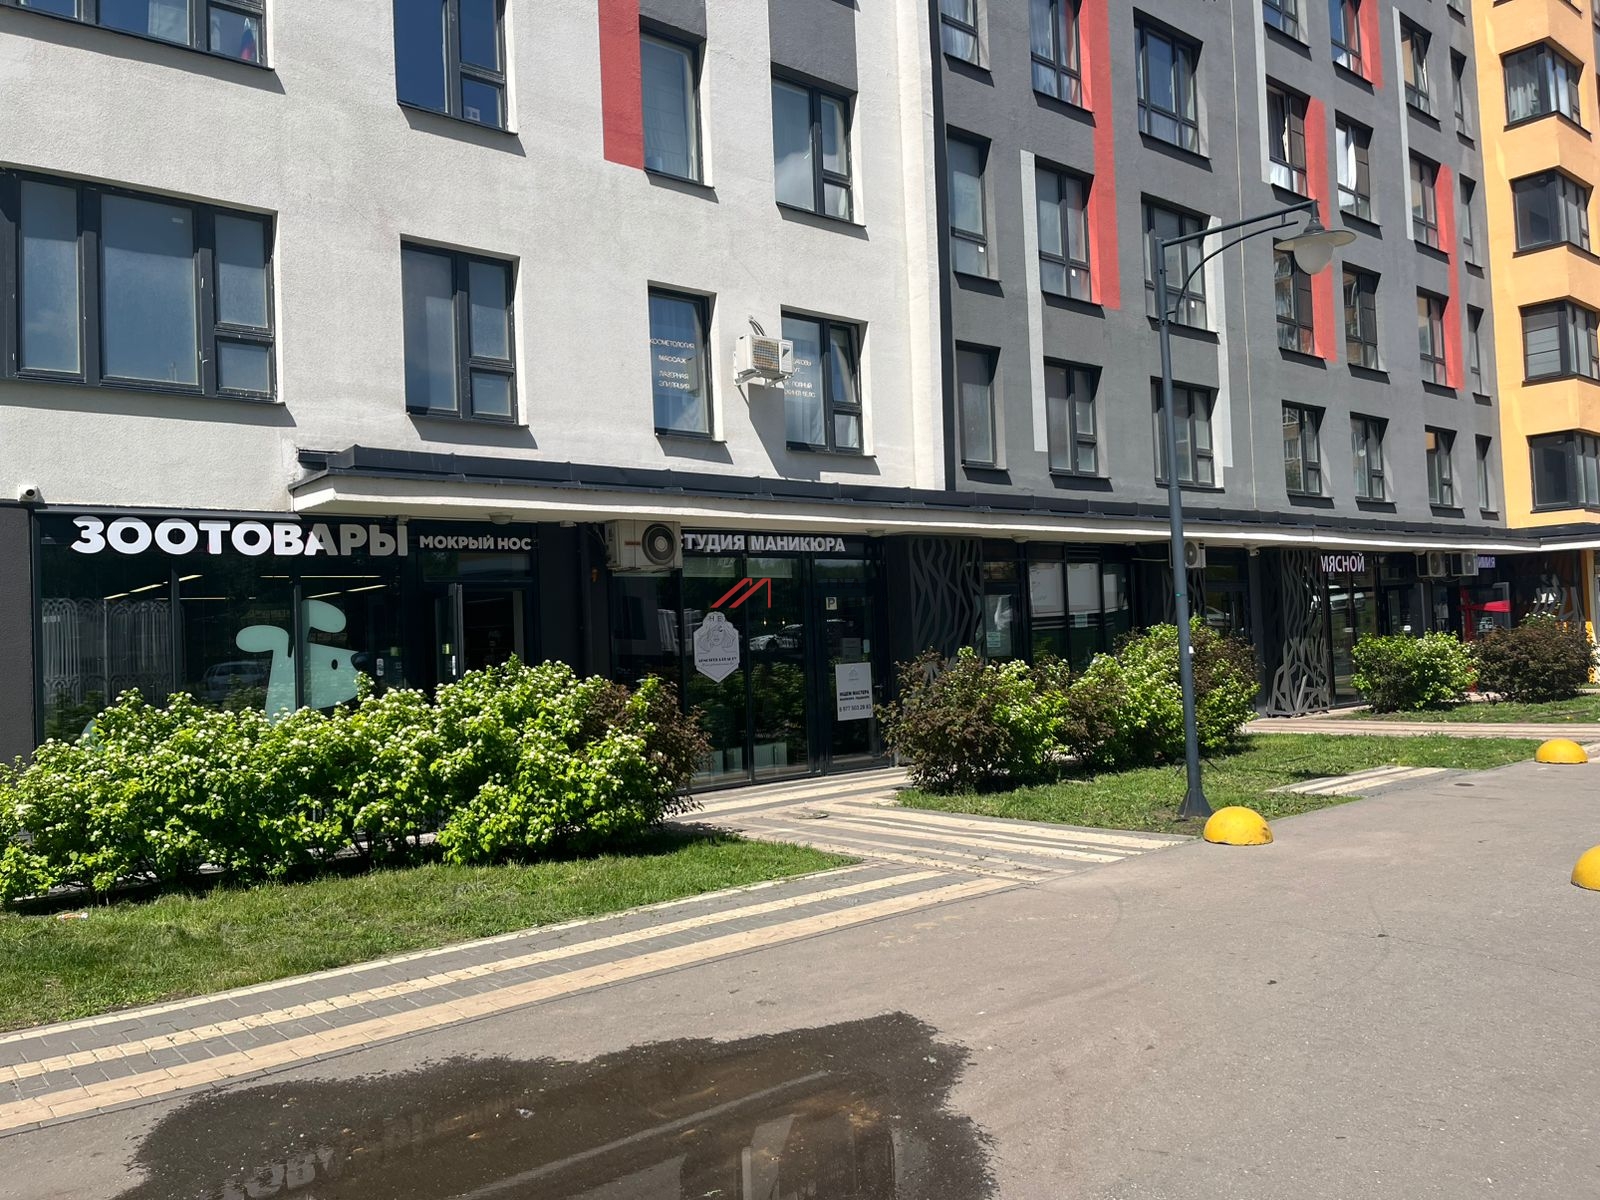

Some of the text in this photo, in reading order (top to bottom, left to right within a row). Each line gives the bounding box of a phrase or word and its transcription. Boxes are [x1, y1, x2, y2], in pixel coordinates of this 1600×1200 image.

[70, 515, 409, 557] ЗООТОВАРЫ
[419, 534, 532, 551] МОКРЫЙ НОС
[749, 535, 846, 553] МАНИКЮРА
[1320, 552, 1365, 573] МЯСНОЙ
